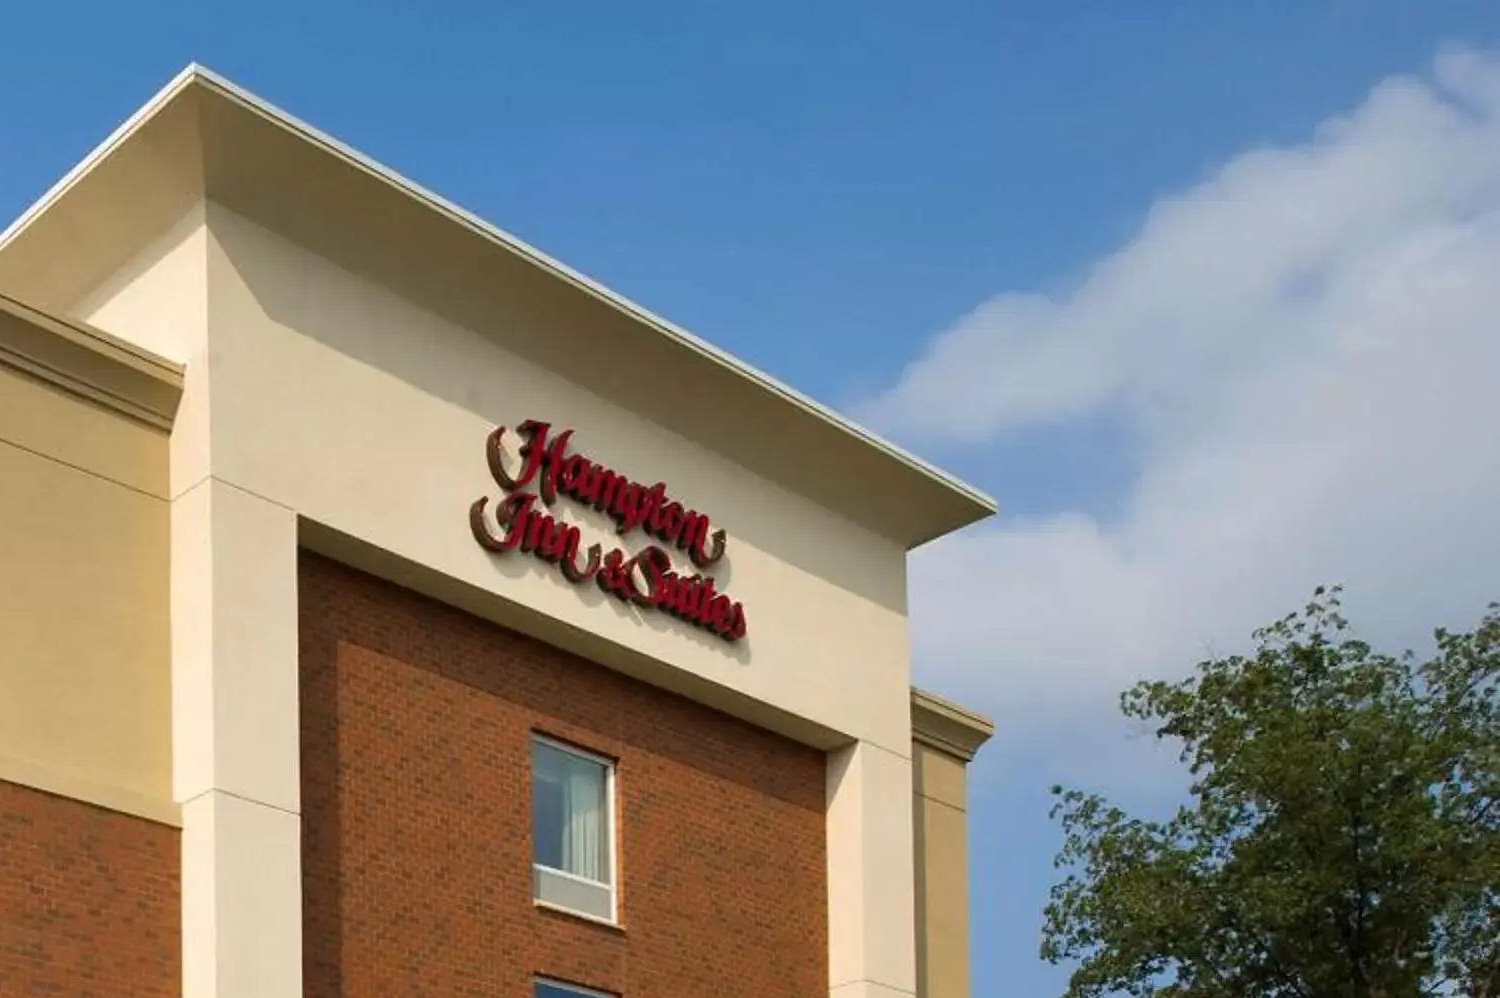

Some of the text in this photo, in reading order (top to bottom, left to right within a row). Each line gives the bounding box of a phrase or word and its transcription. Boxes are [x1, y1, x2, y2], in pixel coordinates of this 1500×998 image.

[470, 492, 747, 641] Inn & Suites
[486, 419, 726, 568] Hampton
